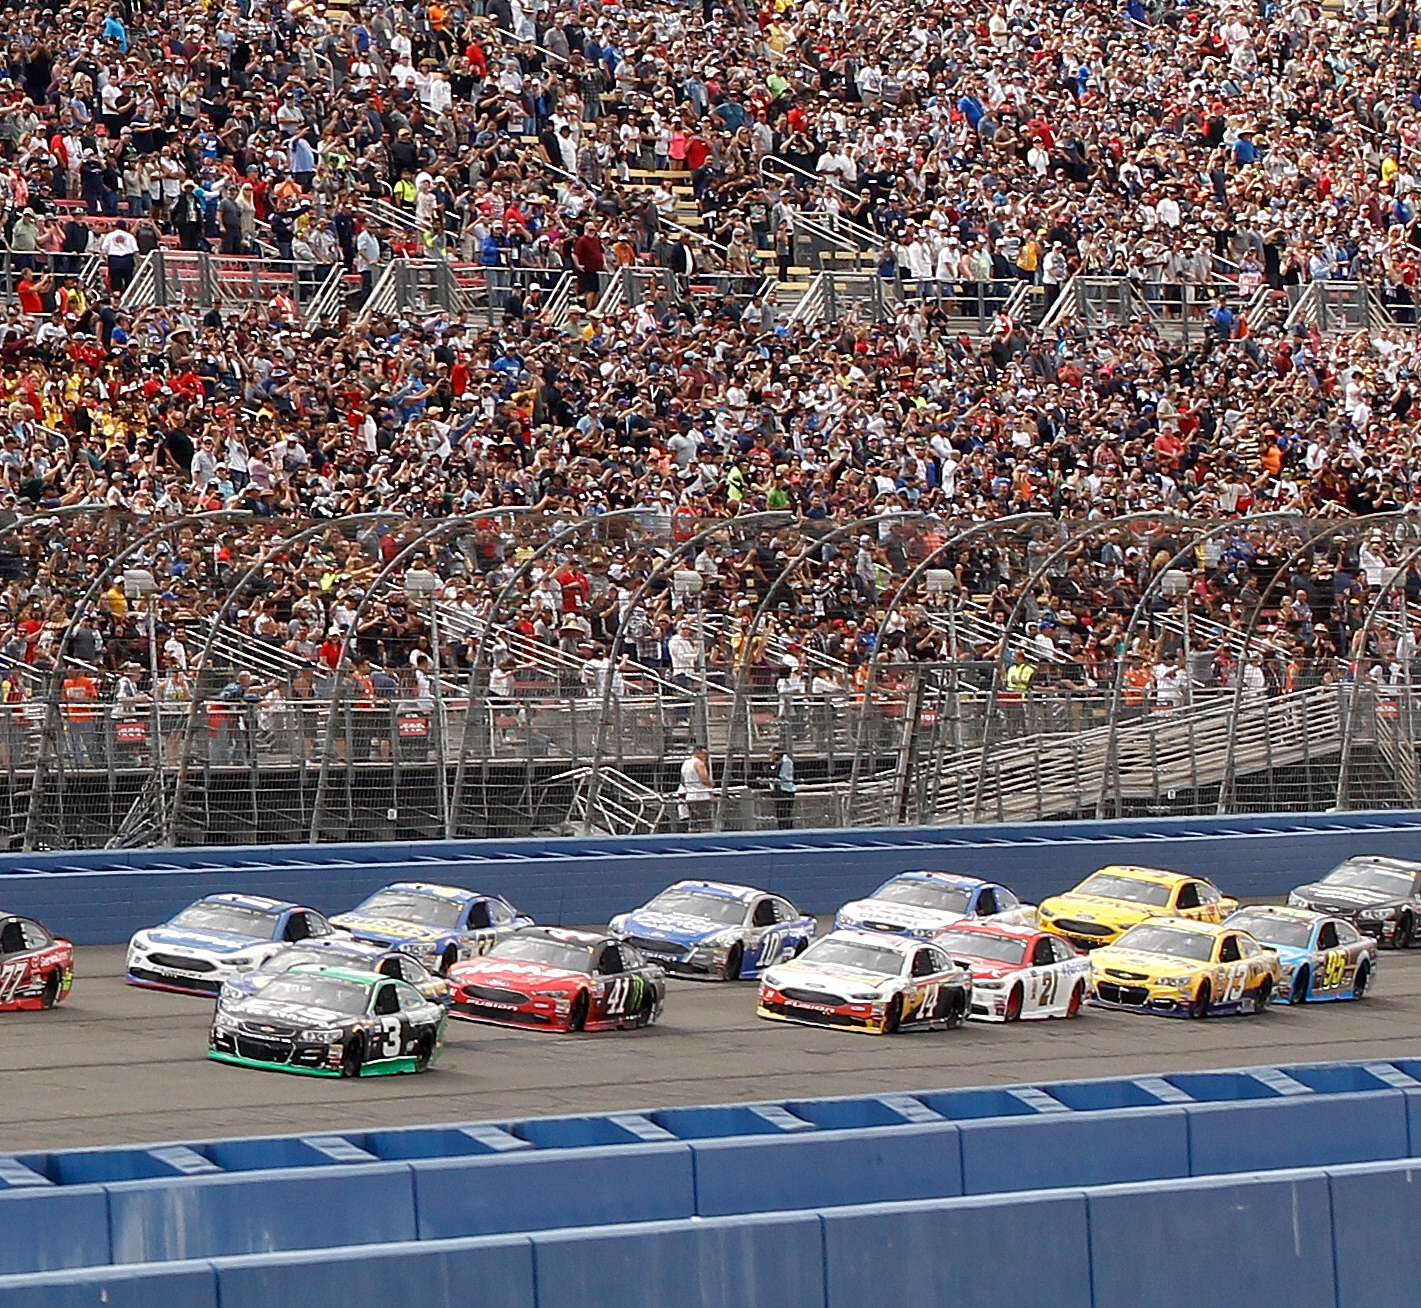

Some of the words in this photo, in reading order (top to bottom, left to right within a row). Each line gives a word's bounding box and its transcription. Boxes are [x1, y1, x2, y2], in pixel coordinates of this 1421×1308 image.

[756, 932, 781, 967] 10
[1038, 970, 1058, 1007] 21
[1224, 964, 1248, 1002] 13
[1323, 950, 1346, 990] 95
[606, 977, 630, 1015] 41
[916, 984, 939, 1019] 14
[380, 1016, 402, 1058] 3
